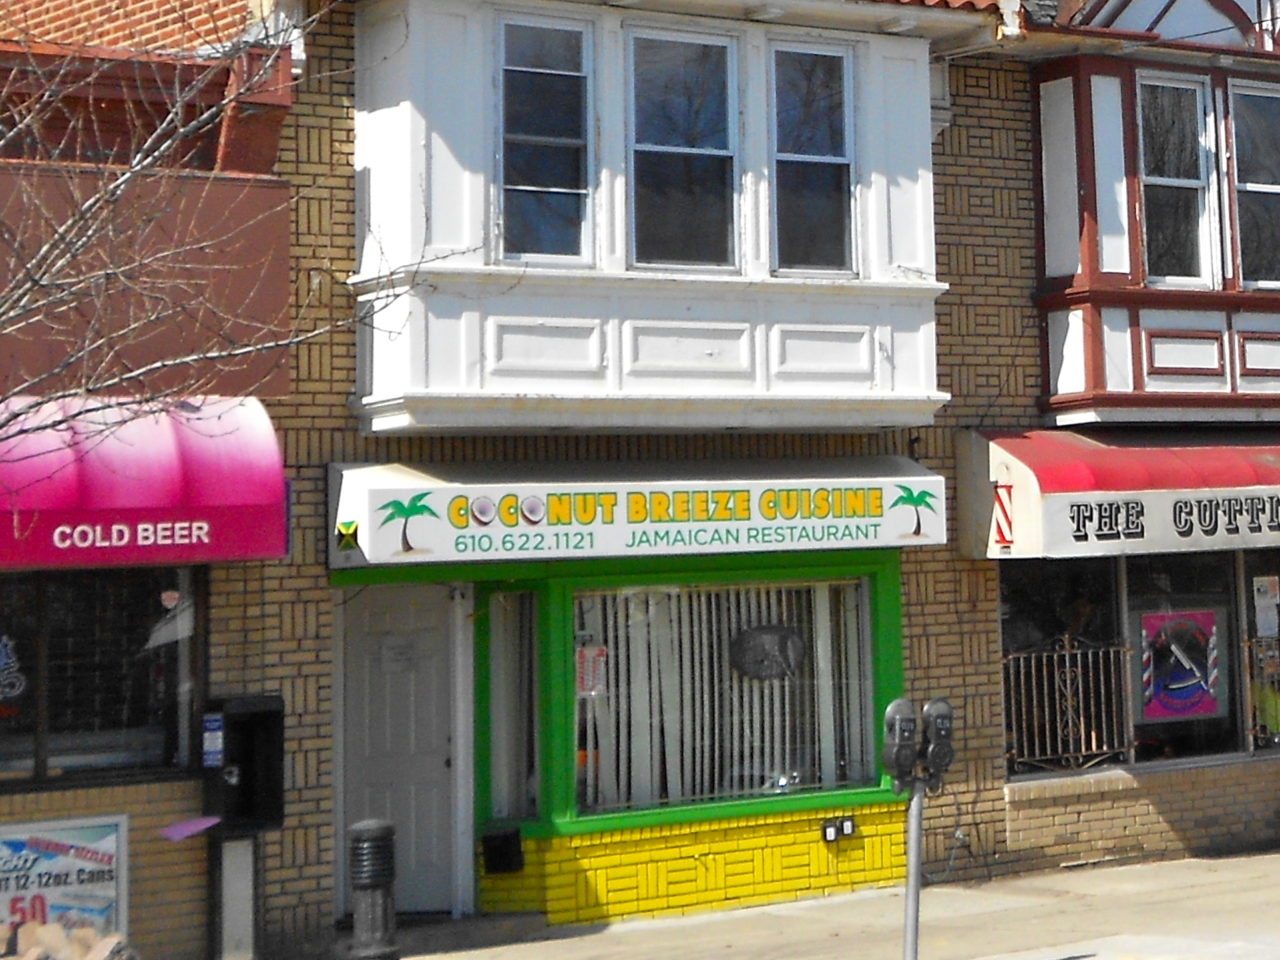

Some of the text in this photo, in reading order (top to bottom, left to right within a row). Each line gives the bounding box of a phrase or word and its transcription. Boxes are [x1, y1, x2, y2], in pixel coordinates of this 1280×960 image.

[447, 488, 884, 529] COCONUT BREEZE CUISINE
[1069, 501, 1146, 543] THE
[53, 522, 209, 548] COLD BEER
[455, 523, 881, 553] 610.622.1121 JAMAICAN RESTAURANT
[77, 868, 114, 885] Cans
